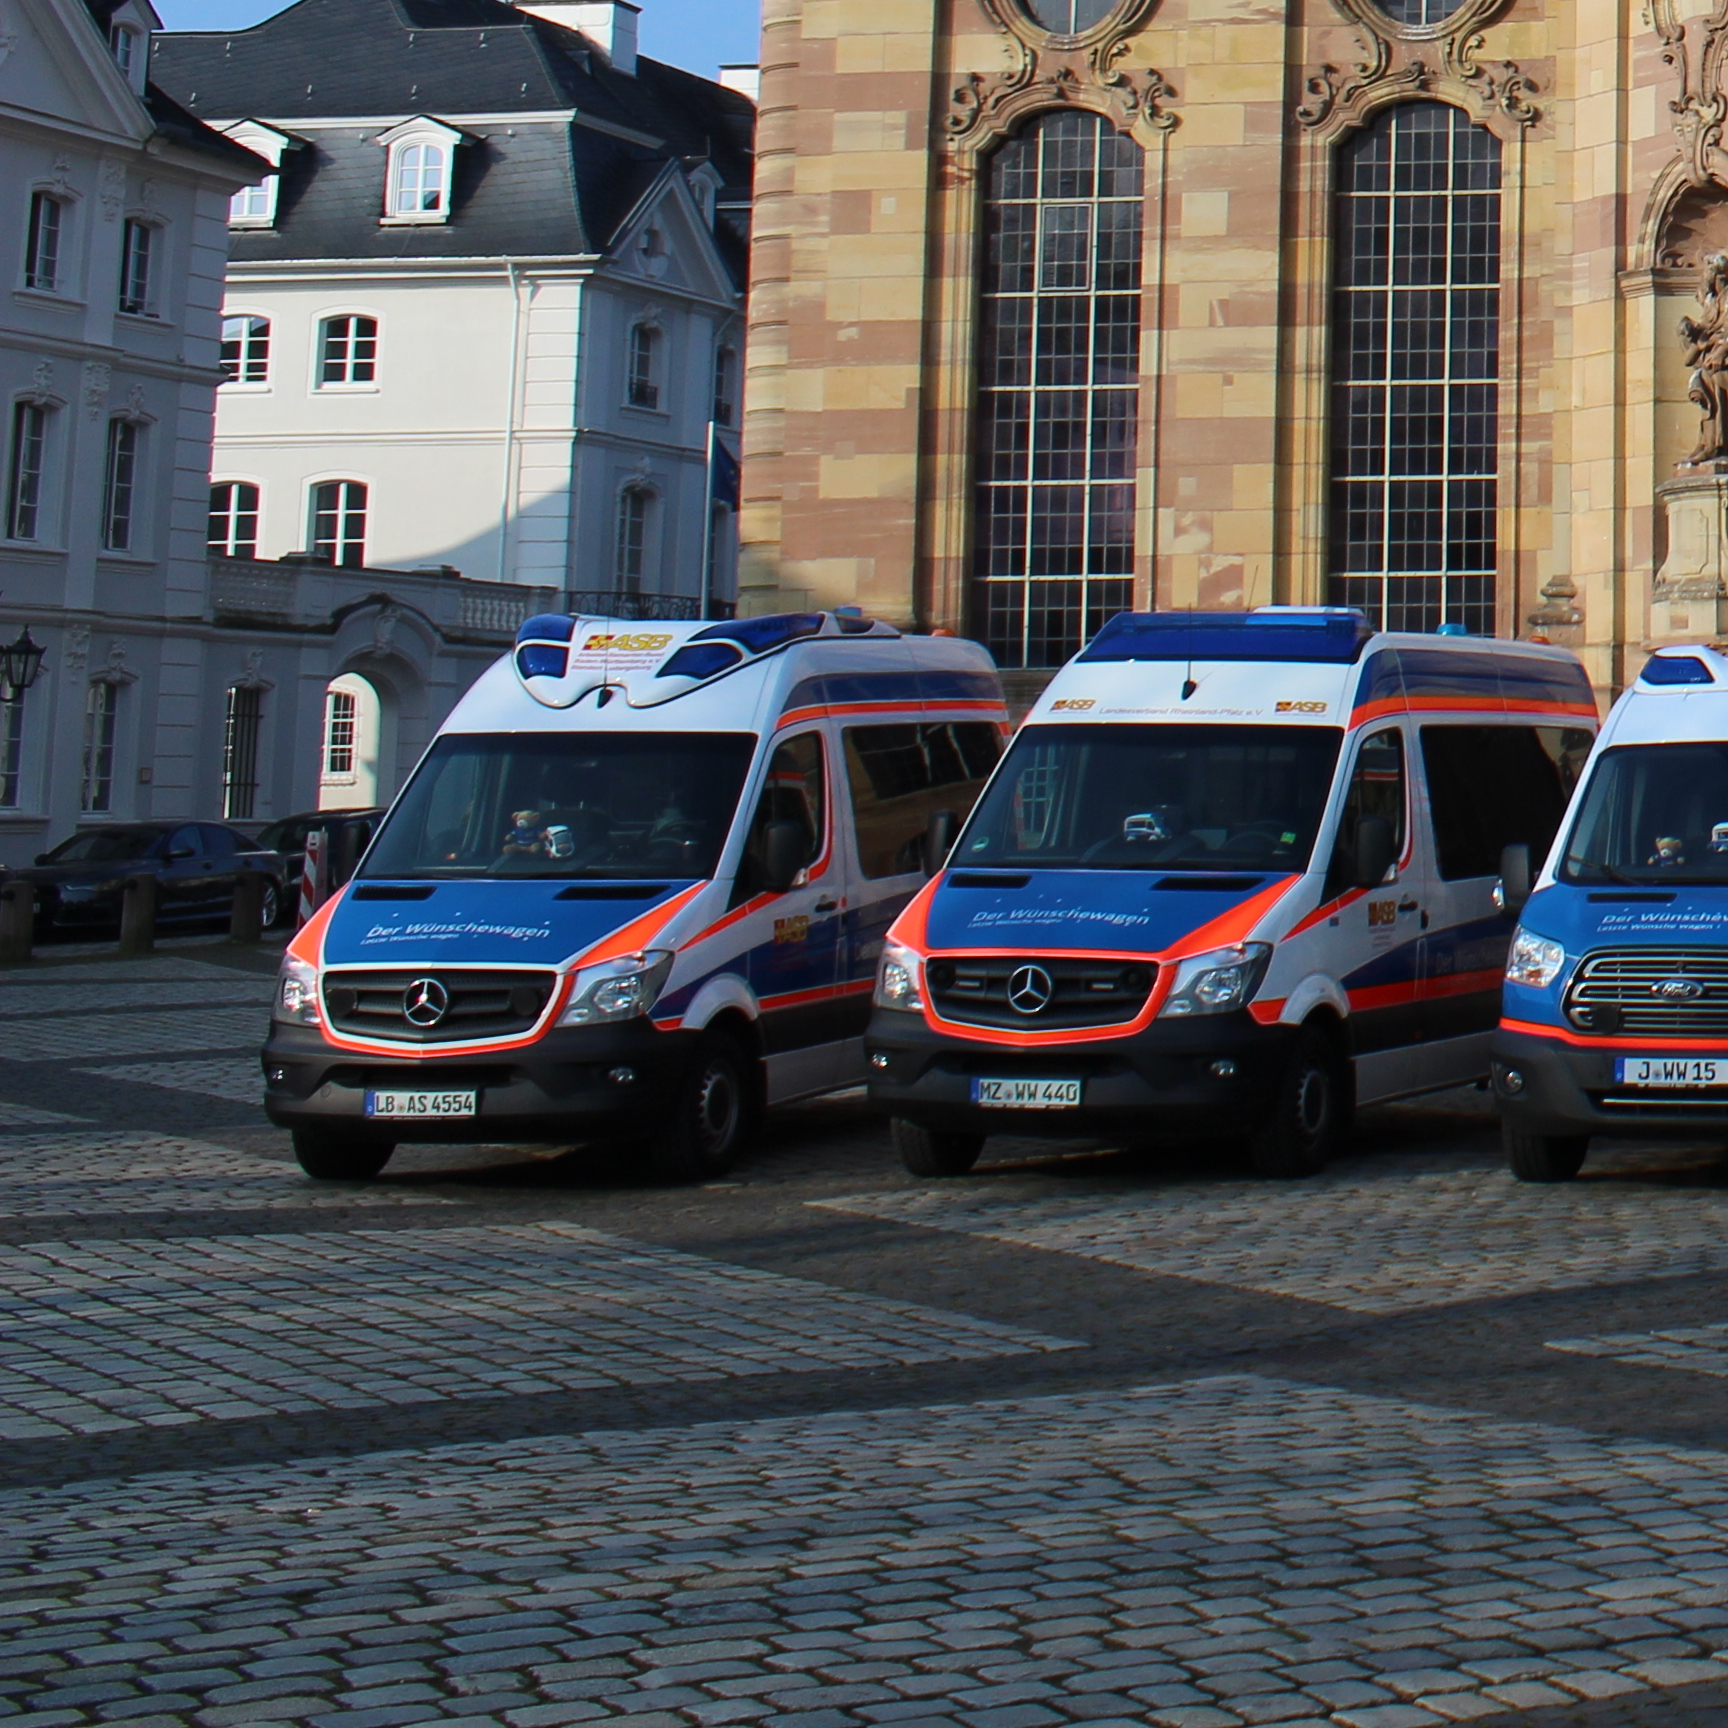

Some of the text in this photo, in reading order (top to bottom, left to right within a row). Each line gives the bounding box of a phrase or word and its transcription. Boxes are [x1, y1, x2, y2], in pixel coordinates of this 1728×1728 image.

[606, 633, 674, 652] ASB
[1289, 700, 1327, 713] ASB
[972, 908, 1151, 926] Der Wünschewagen
[1602, 914, 1635, 924] Der
[366, 921, 551, 938] Der Wünschewagen
[1661, 982, 1692, 996] Ford
[1637, 1061, 1717, 1081] J WW 15
[981, 1081, 1077, 1102] MZ WW 440
[375, 1093, 474, 1113] LB AS 4554
